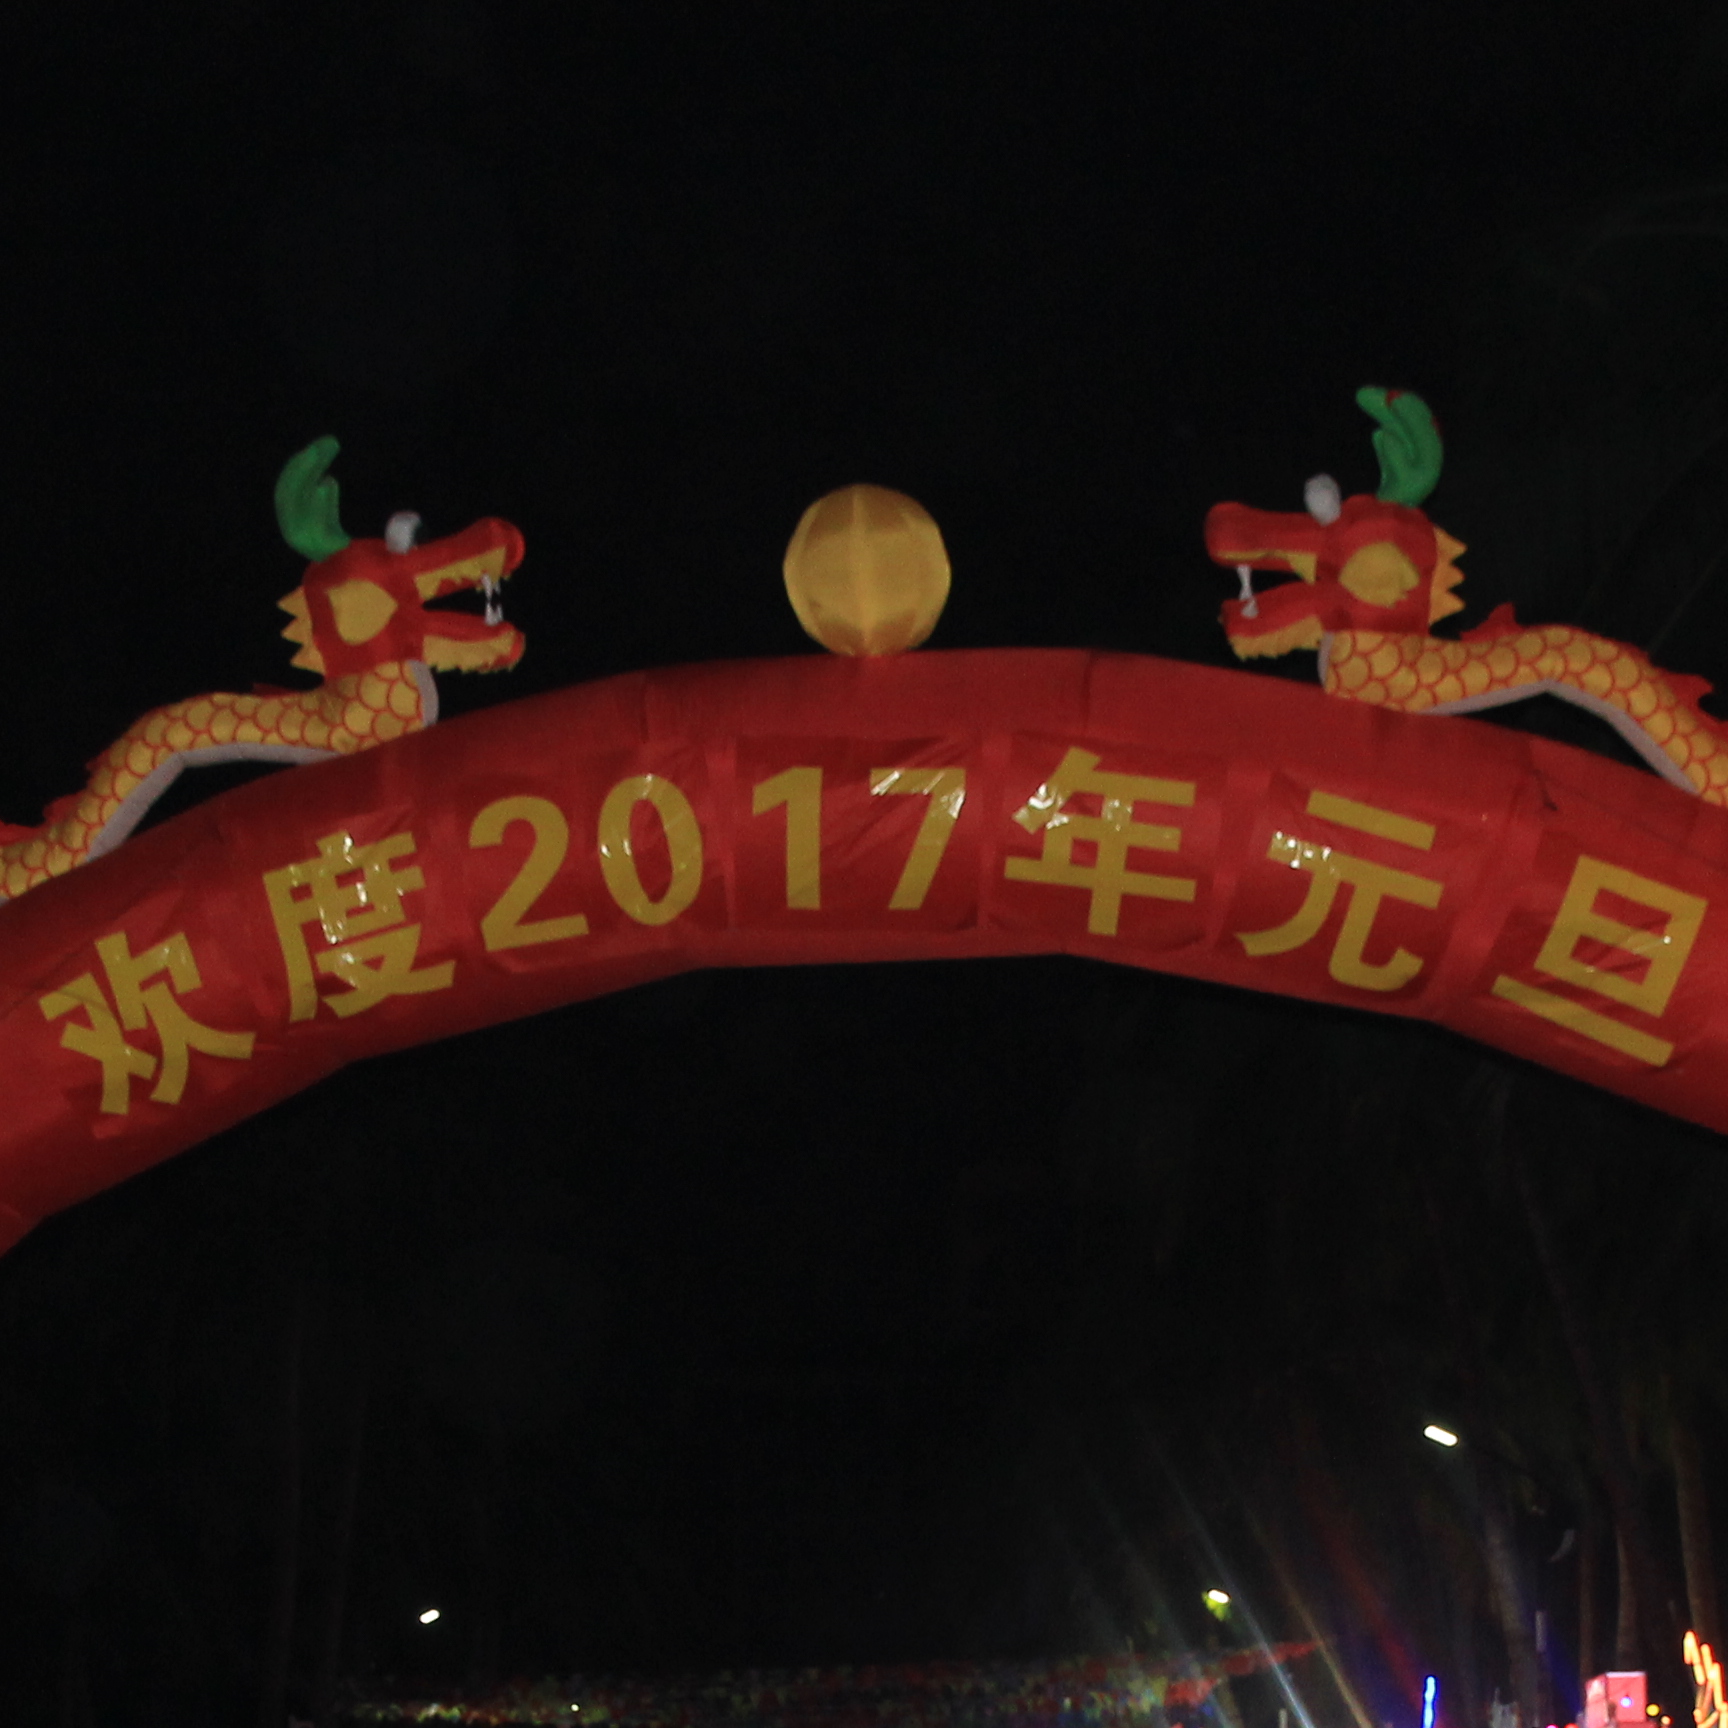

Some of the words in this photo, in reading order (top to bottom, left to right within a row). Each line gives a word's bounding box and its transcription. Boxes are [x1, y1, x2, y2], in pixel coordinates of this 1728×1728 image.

[41, 747, 1710, 1117] 欢度2017年元旦
